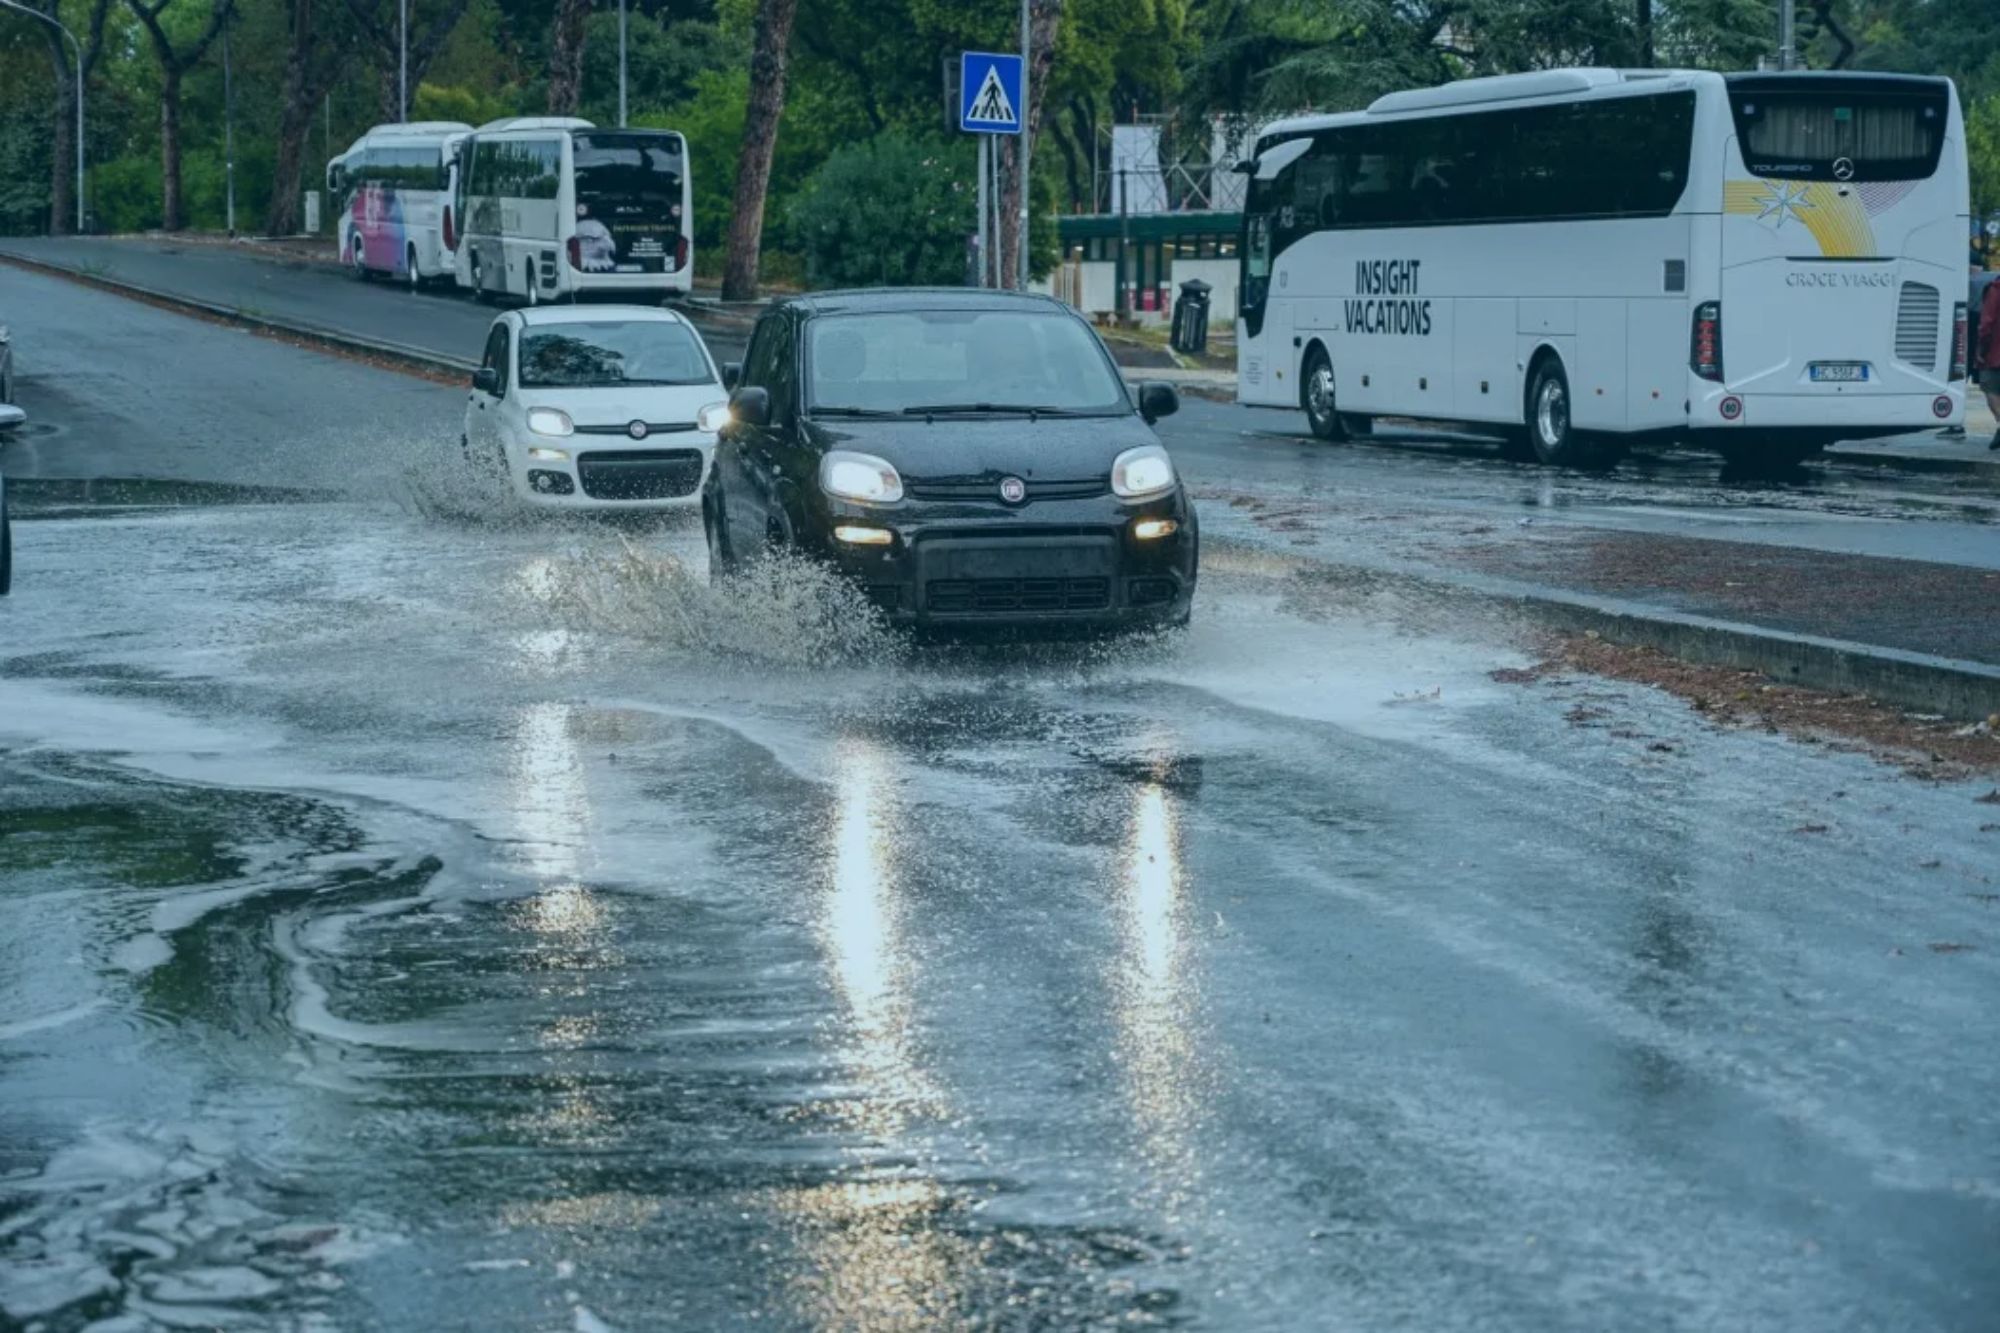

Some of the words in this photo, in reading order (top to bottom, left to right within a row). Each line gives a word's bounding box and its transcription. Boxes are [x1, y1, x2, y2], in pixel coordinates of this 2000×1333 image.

[1356, 259, 1420, 295] INSIGHT
[1785, 272, 1837, 288] CROCE
[1841, 272, 1896, 288] VIAGGI
[1344, 299, 1431, 336] VACATIONS
